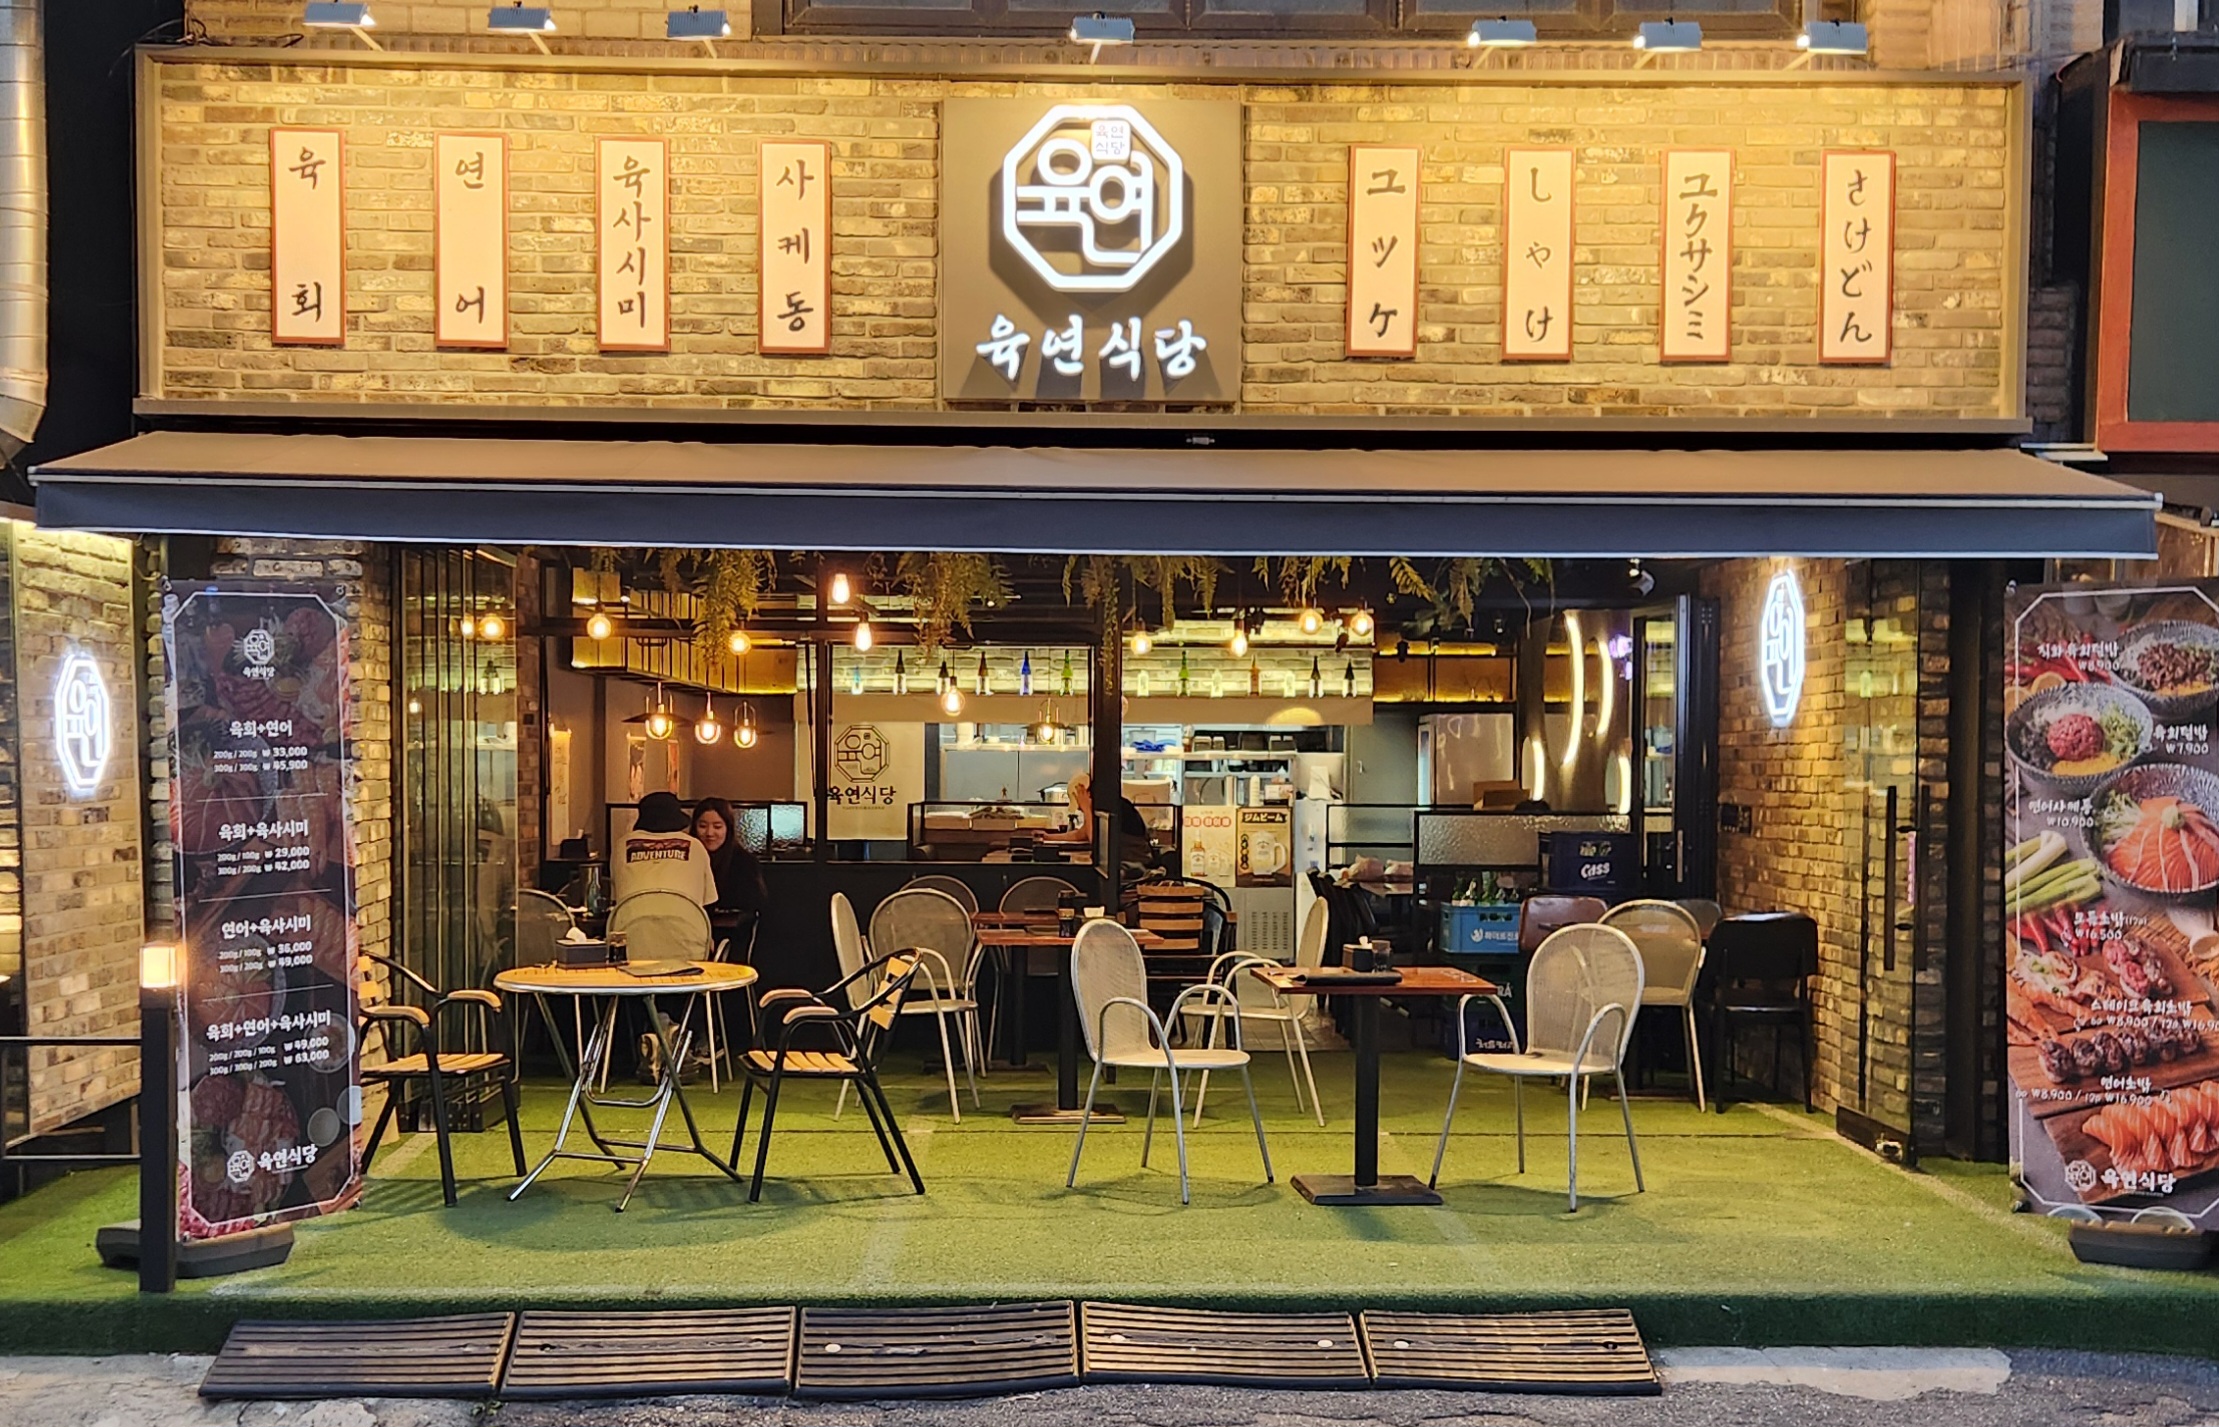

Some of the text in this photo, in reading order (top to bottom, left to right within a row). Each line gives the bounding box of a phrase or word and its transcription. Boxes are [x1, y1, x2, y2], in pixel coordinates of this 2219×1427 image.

[288, 146, 326, 323] 육회
[455, 151, 487, 324] 연어
[612, 154, 652, 328] 육사시미
[776, 159, 815, 333] 사케동
[1678, 173, 1718, 340] ユクサシミ
[1839, 170, 1873, 345] さけどん
[229, 720, 293, 739] 육회+연어
[827, 785, 897, 805] 육연식당
[218, 819, 309, 841] 육회+육사시미
[631, 849, 687, 863] ADVENTURE
[221, 914, 311, 939] 연어+육사시미
[206, 1010, 331, 1042] 육회+연어+육사시미
[257, 1144, 318, 1172] 육연식당
[2101, 1168, 2177, 1194] 육연식당
